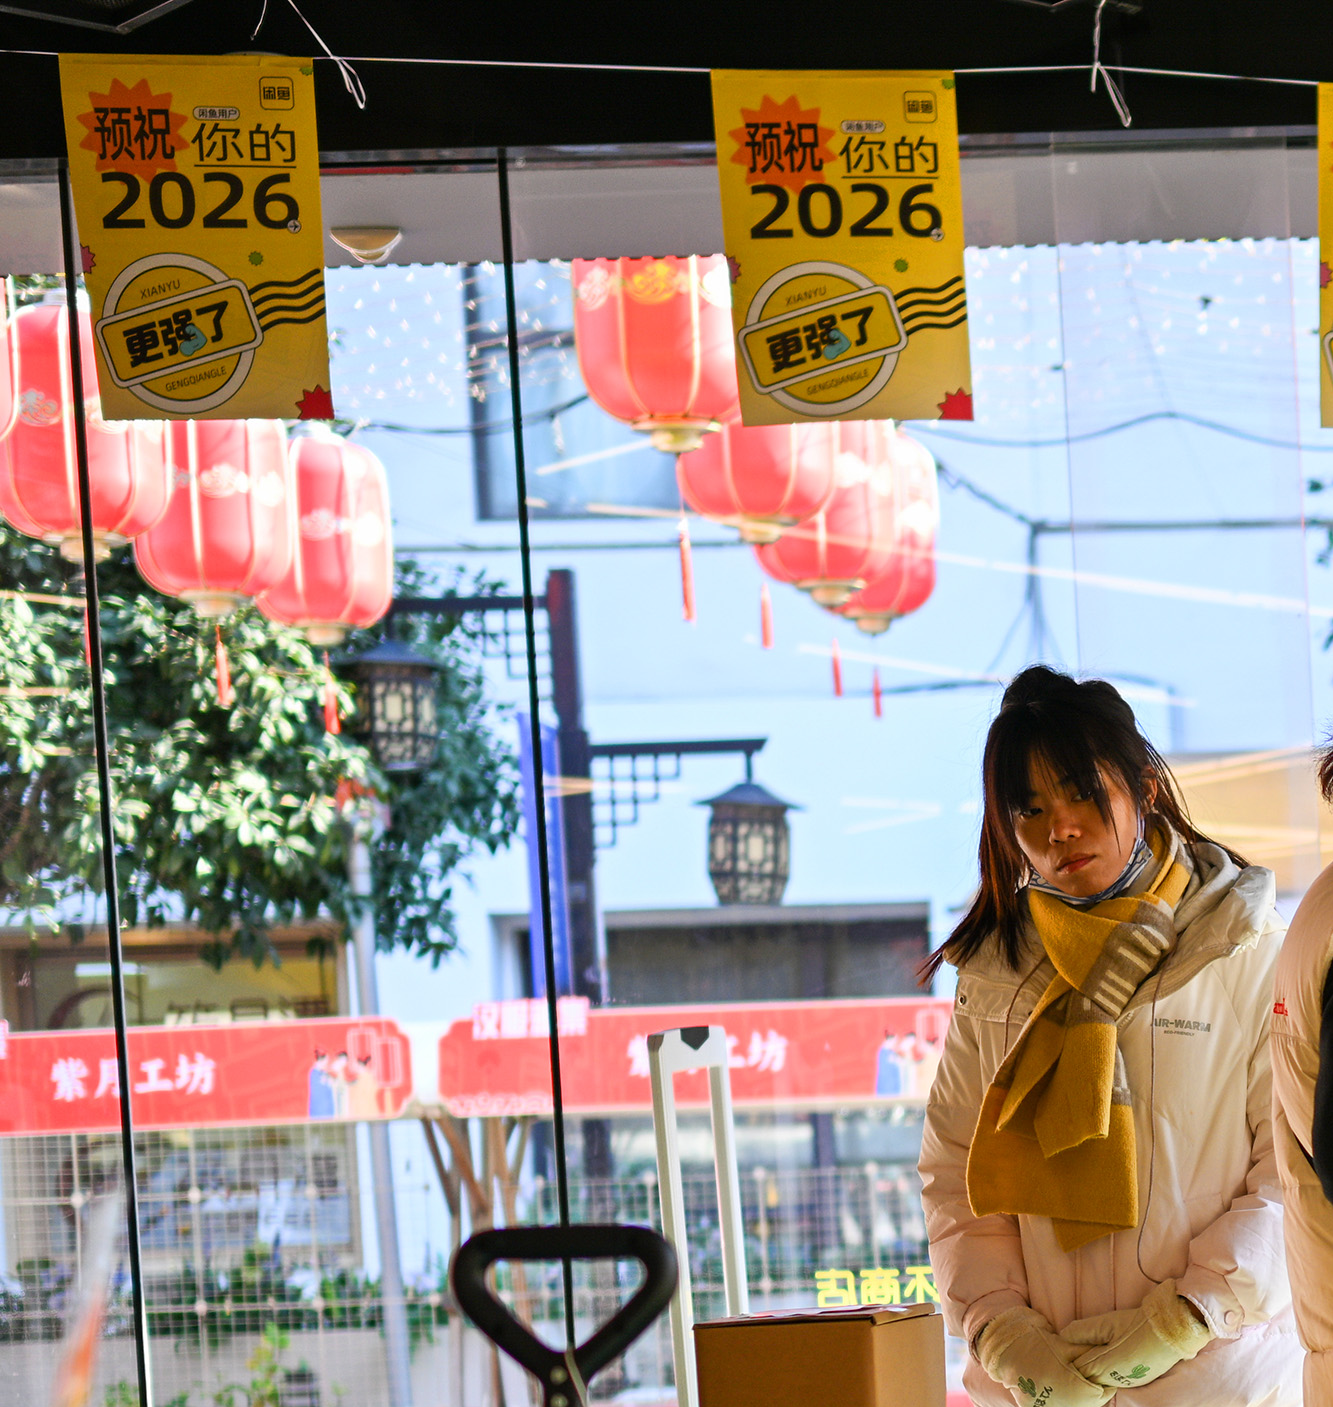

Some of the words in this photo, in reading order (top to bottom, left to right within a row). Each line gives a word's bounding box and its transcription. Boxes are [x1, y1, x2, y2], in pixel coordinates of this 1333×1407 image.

[198, 107, 238, 119] 闲鱼用户
[263, 86, 291, 101] 闲鱼
[93, 106, 175, 161] 预祝
[191, 123, 296, 163] 你的
[744, 121, 823, 173] 预祝
[839, 136, 938, 173] 你的
[101, 172, 300, 230] 2026
[750, 183, 942, 239] 2026
[140, 279, 181, 299] XIANYU
[786, 286, 827, 307] XIANYU
[122, 301, 228, 368] 更强了
[766, 306, 874, 374] 更强了
[165, 366, 227, 392] GENGQIANGLE
